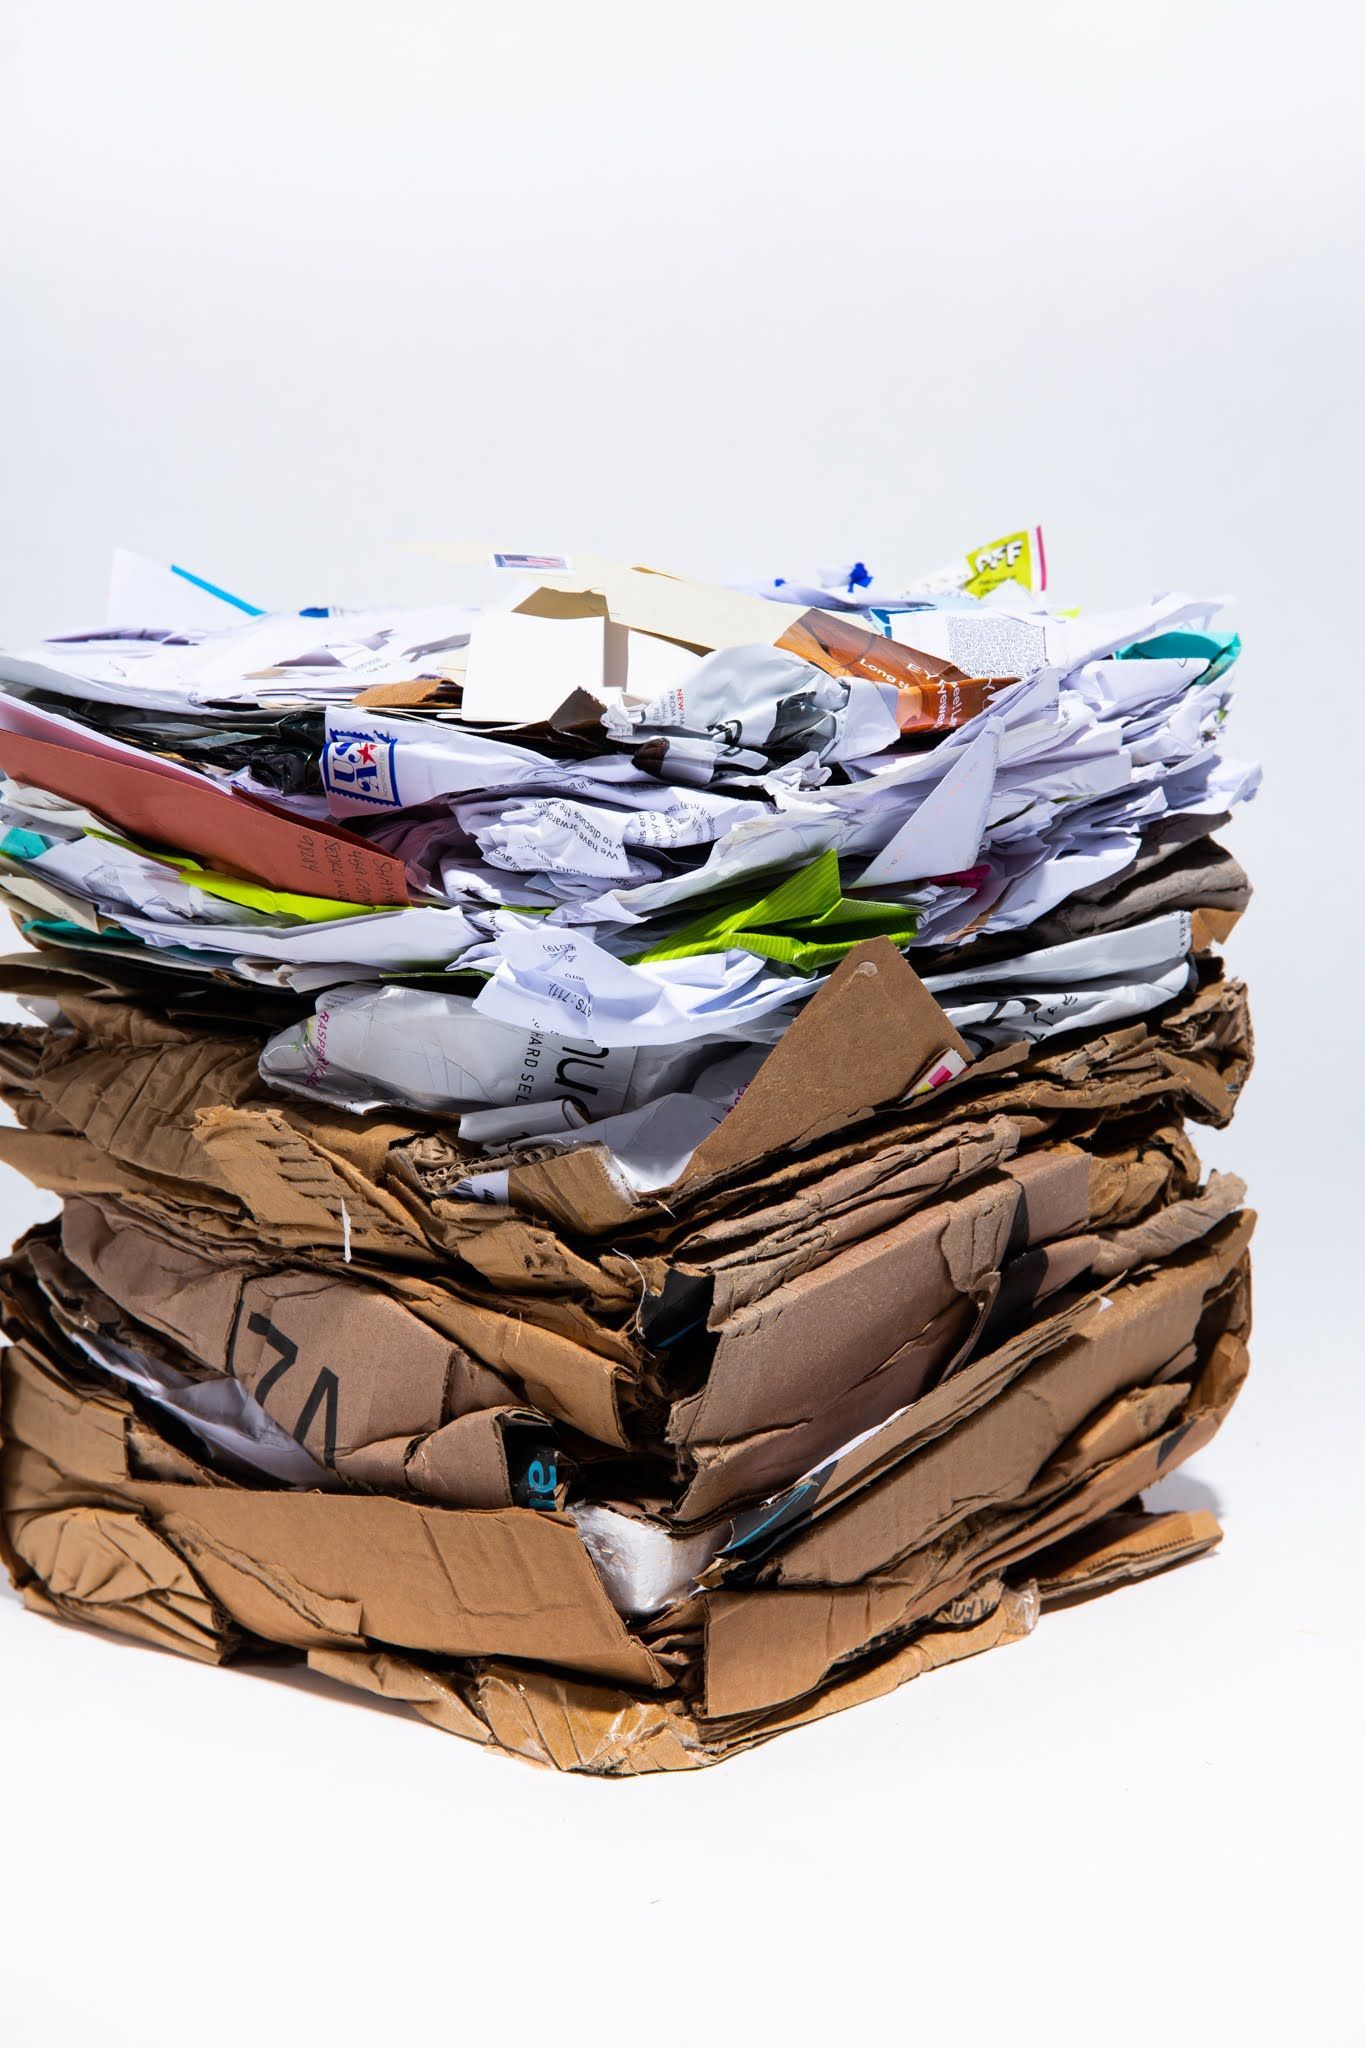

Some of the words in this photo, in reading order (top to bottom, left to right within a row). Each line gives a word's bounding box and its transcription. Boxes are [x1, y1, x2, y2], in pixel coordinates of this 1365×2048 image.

[859, 659, 897, 682] Long
[668, 690, 676, 717] FROM
[559, 802, 572, 817] the
[574, 811, 601, 838] discuss
[579, 832, 598, 852] have
[603, 837, 612, 847] to
[600, 847, 619, 861] We
[524, 1030, 544, 1068] HARD
